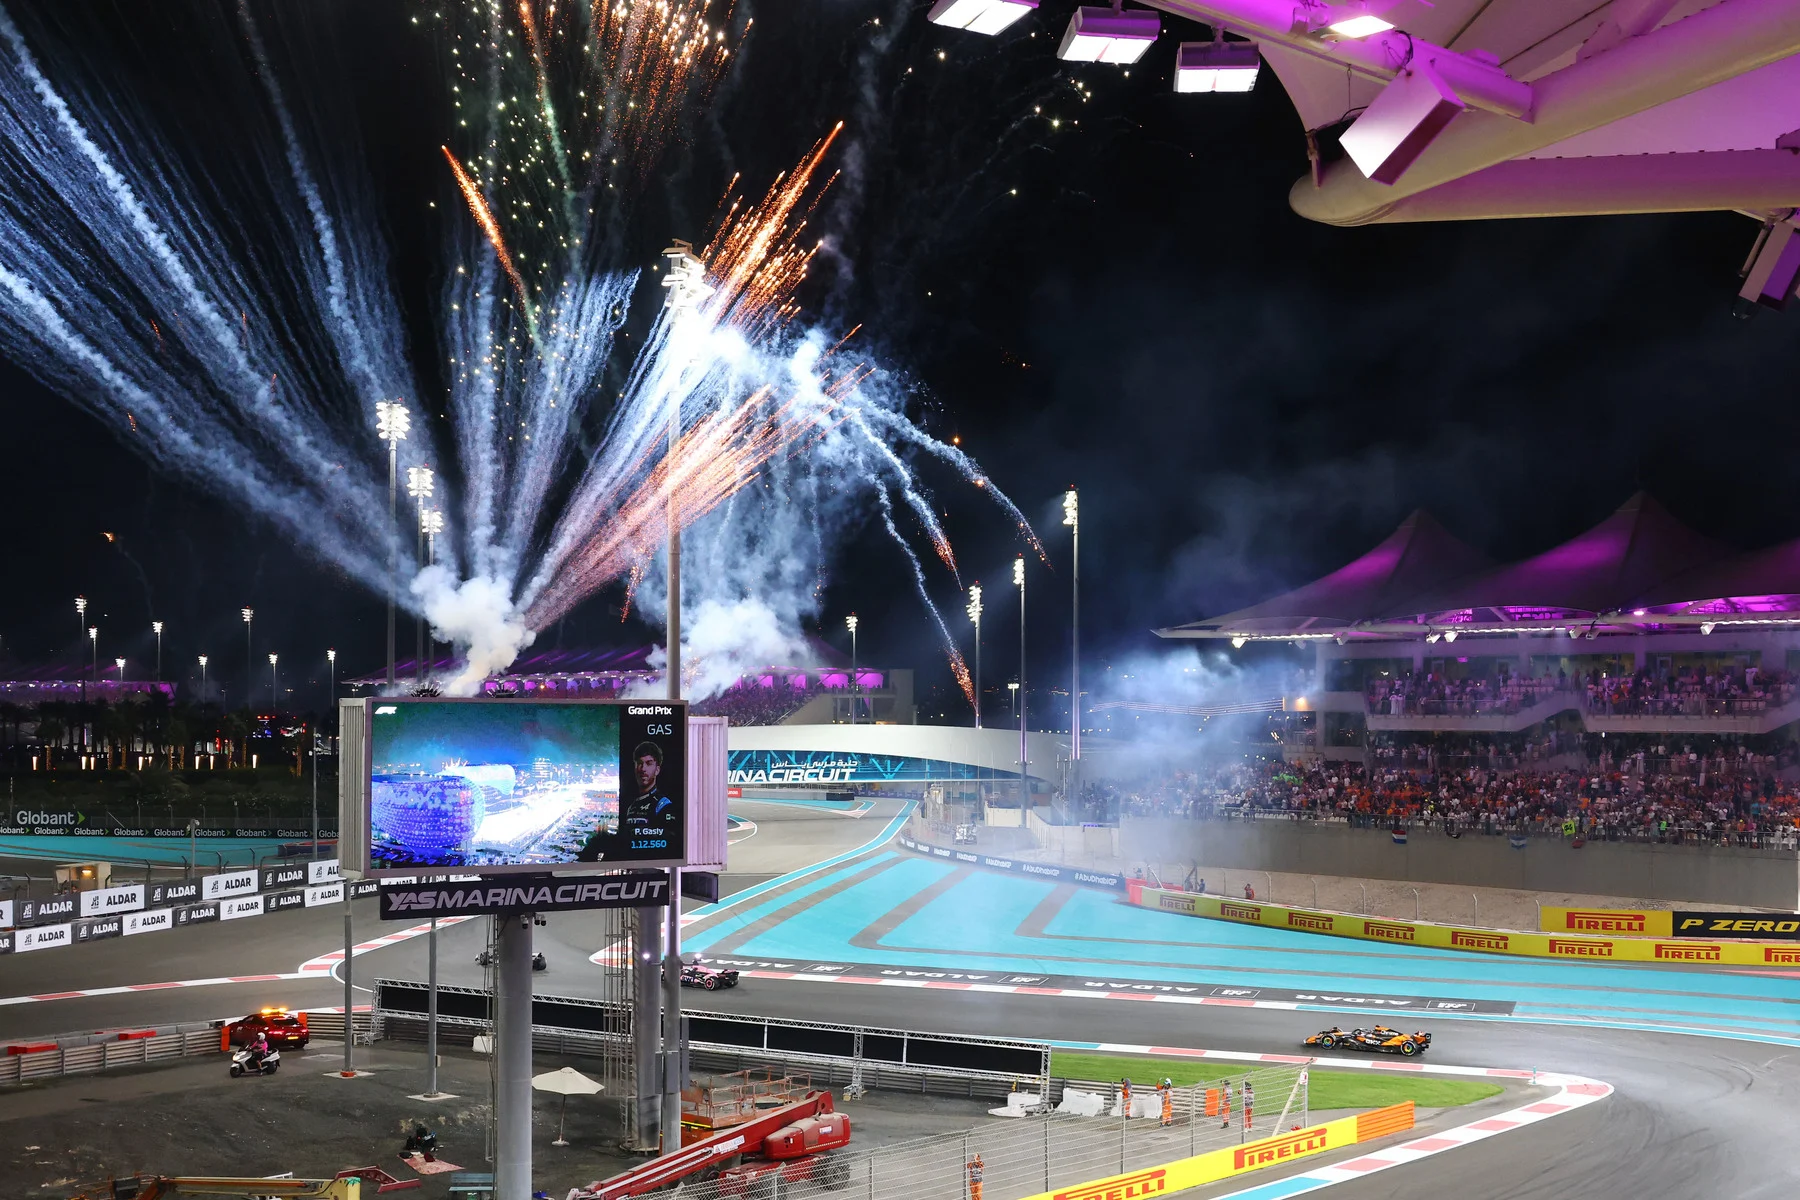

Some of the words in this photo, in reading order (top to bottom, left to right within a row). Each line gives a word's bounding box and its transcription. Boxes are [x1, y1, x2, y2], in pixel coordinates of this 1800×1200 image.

[628, 706, 653, 715] Grand
[655, 706, 672, 715] Prix
[647, 724, 672, 735] GAS
[16, 810, 75, 825] Globant
[34, 827, 64, 835] Globant
[74, 827, 104, 836] Globant
[114, 828, 144, 836] Globant
[154, 828, 184, 837] Globant
[195, 828, 225, 837] Globant
[236, 829, 266, 837] Globant
[277, 829, 308, 838] Globant
[642, 827, 664, 836] Gasly
[1074, 872, 1118, 886] #AbuDhabiGP
[39, 900, 73, 915] ALDAR
[106, 893, 137, 906] ALDAR
[166, 885, 197, 899] ALDAR
[224, 877, 251, 890] ALDAR
[277, 870, 303, 883] ALDAR
[38, 930, 65, 943] ALDAR
[92, 922, 119, 935] ALDAR
[141, 914, 166, 927] ALDAR
[191, 907, 215, 920] ALDAR
[237, 901, 259, 912] ALDAR
[279, 894, 301, 906] ALDAR
[320, 889, 340, 900] ALDAR
[358, 883, 378, 894] ALDAR
[1160, 894, 1196, 911] PIRELLI
[1221, 903, 1261, 920] PIRELLI
[1288, 912, 1333, 930] PIRELLI
[1364, 921, 1415, 940] PIRELLI
[1451, 931, 1509, 950] PIRELLI
[1549, 939, 1613, 956] PIRELLI
[1655, 944, 1721, 960] PIRELLI
[1566, 912, 1646, 932] PIRELLI
[1680, 918, 1704, 930] P
[1709, 919, 1800, 932] ZERO
[880, 969, 989, 980] ALDAR
[1085, 981, 1199, 992] ALDAR
[1295, 994, 1412, 1005] ALDAR
[1234, 1128, 1327, 1170] PIRELLI
[1053, 1169, 1166, 1200] PELLI
